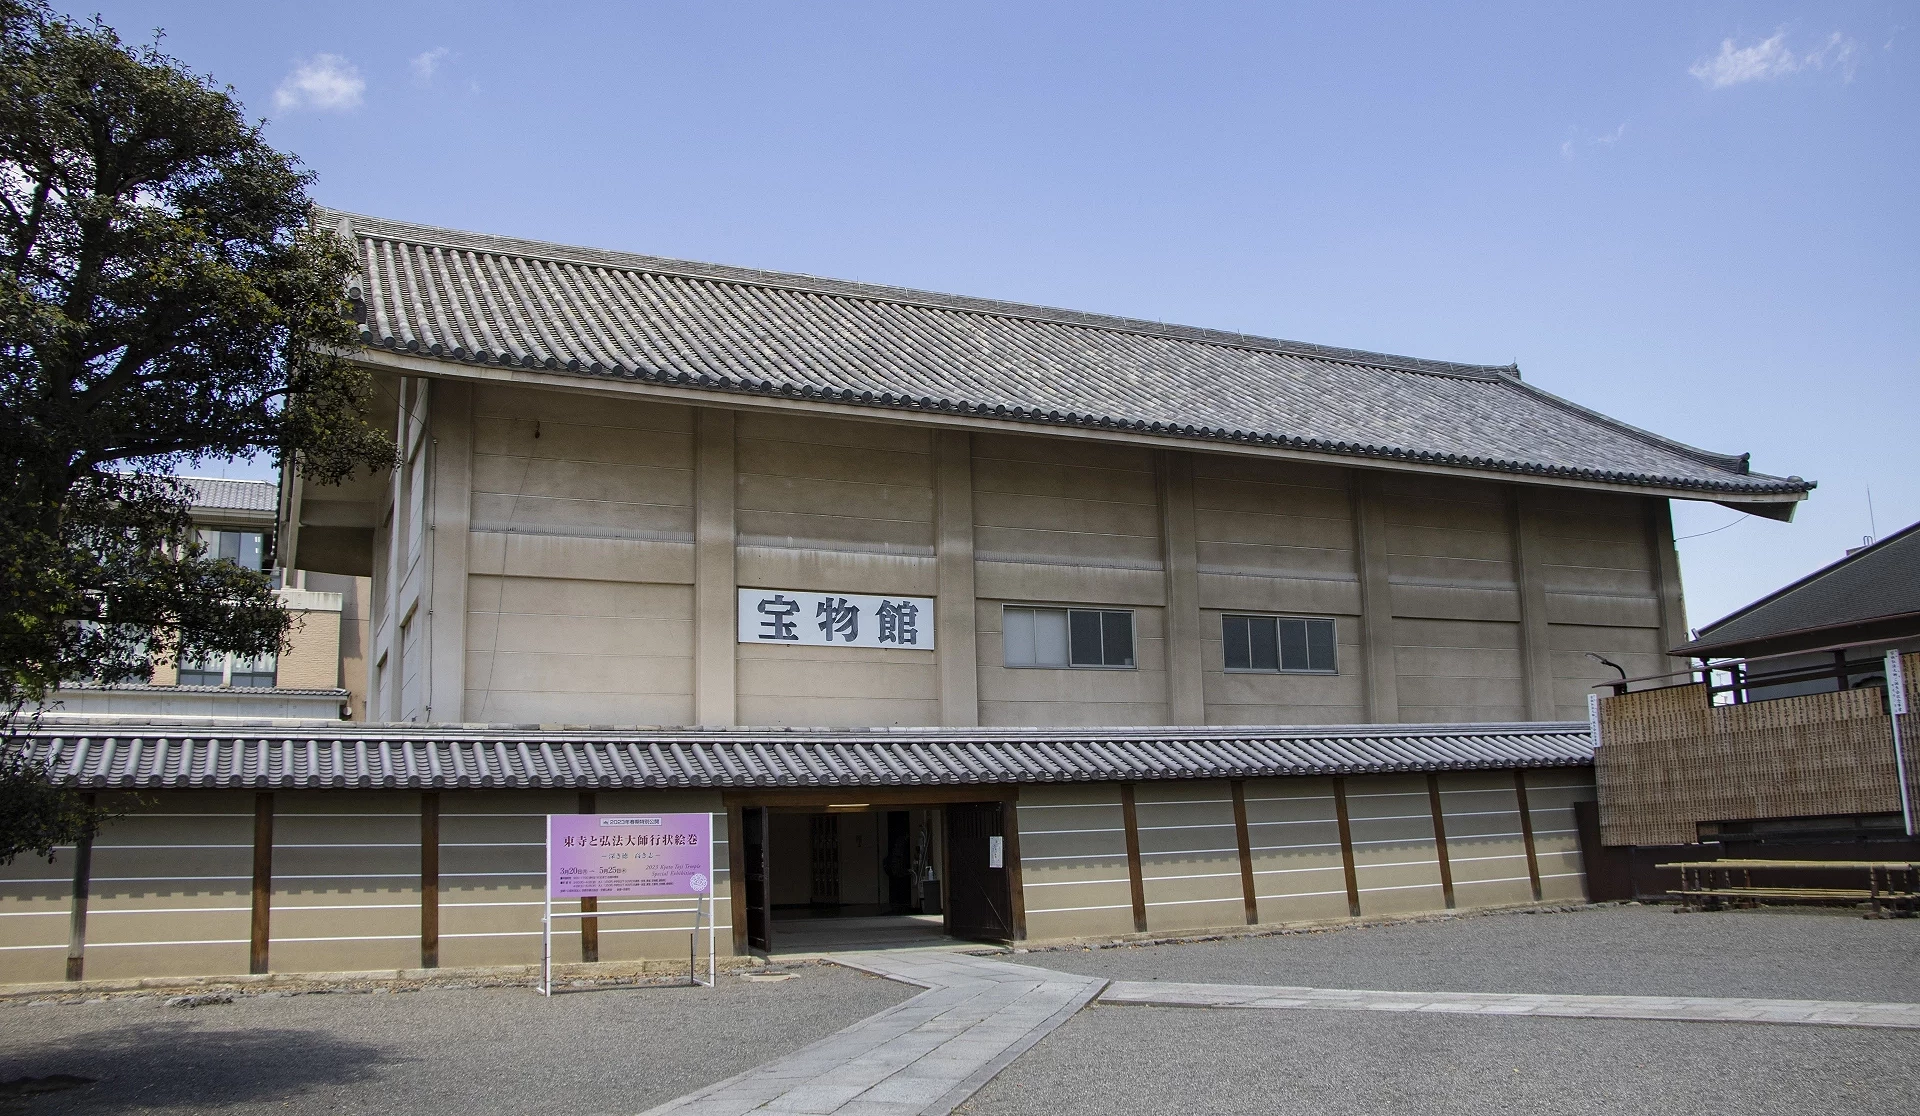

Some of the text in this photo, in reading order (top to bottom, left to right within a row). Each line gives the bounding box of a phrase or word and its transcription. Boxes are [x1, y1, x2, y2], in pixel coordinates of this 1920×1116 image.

[757, 594, 919, 645] 宝物館
[564, 834, 698, 848] 東寺と弘法大師行状絵巻
